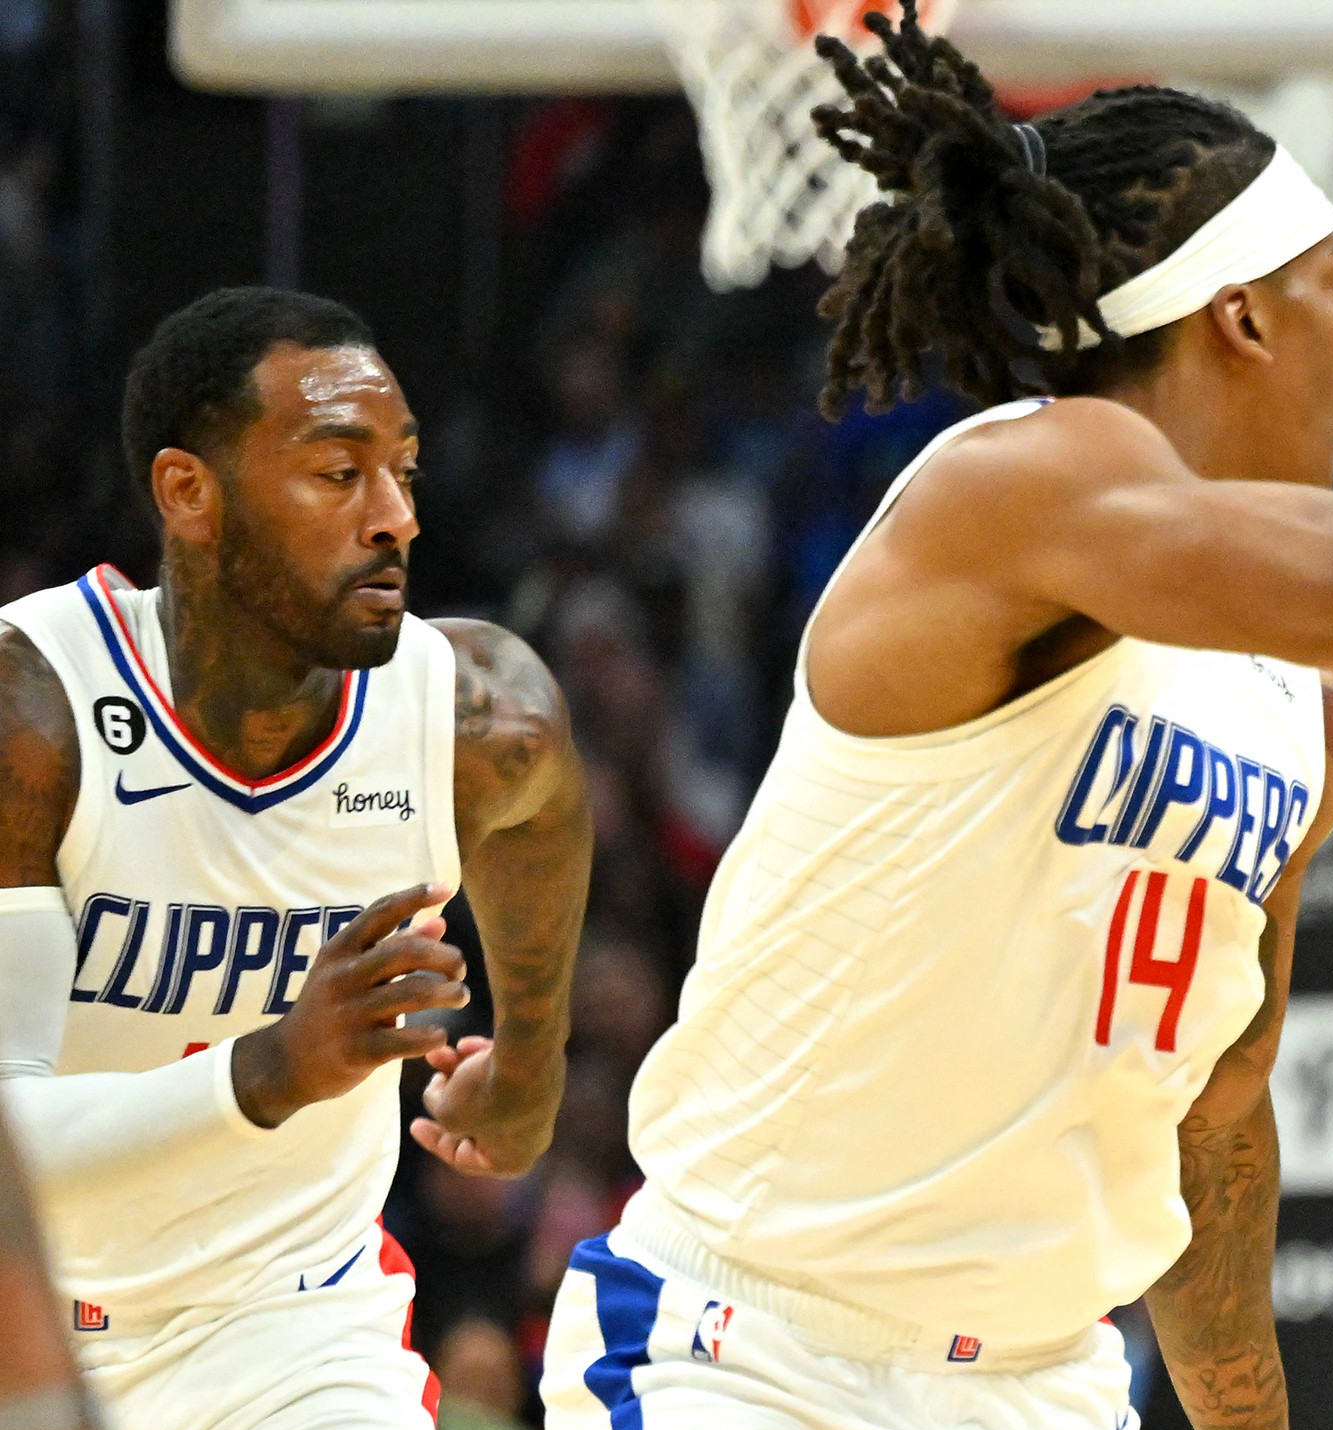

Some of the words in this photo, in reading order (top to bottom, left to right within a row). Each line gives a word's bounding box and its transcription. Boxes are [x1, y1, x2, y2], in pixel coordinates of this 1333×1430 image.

[103, 704, 132, 747] 6
[332, 783, 415, 821] honey
[1055, 704, 1309, 905] CLIPPERS
[70, 893, 412, 1015] CLIPPE
[1096, 870, 1208, 1052] 14
